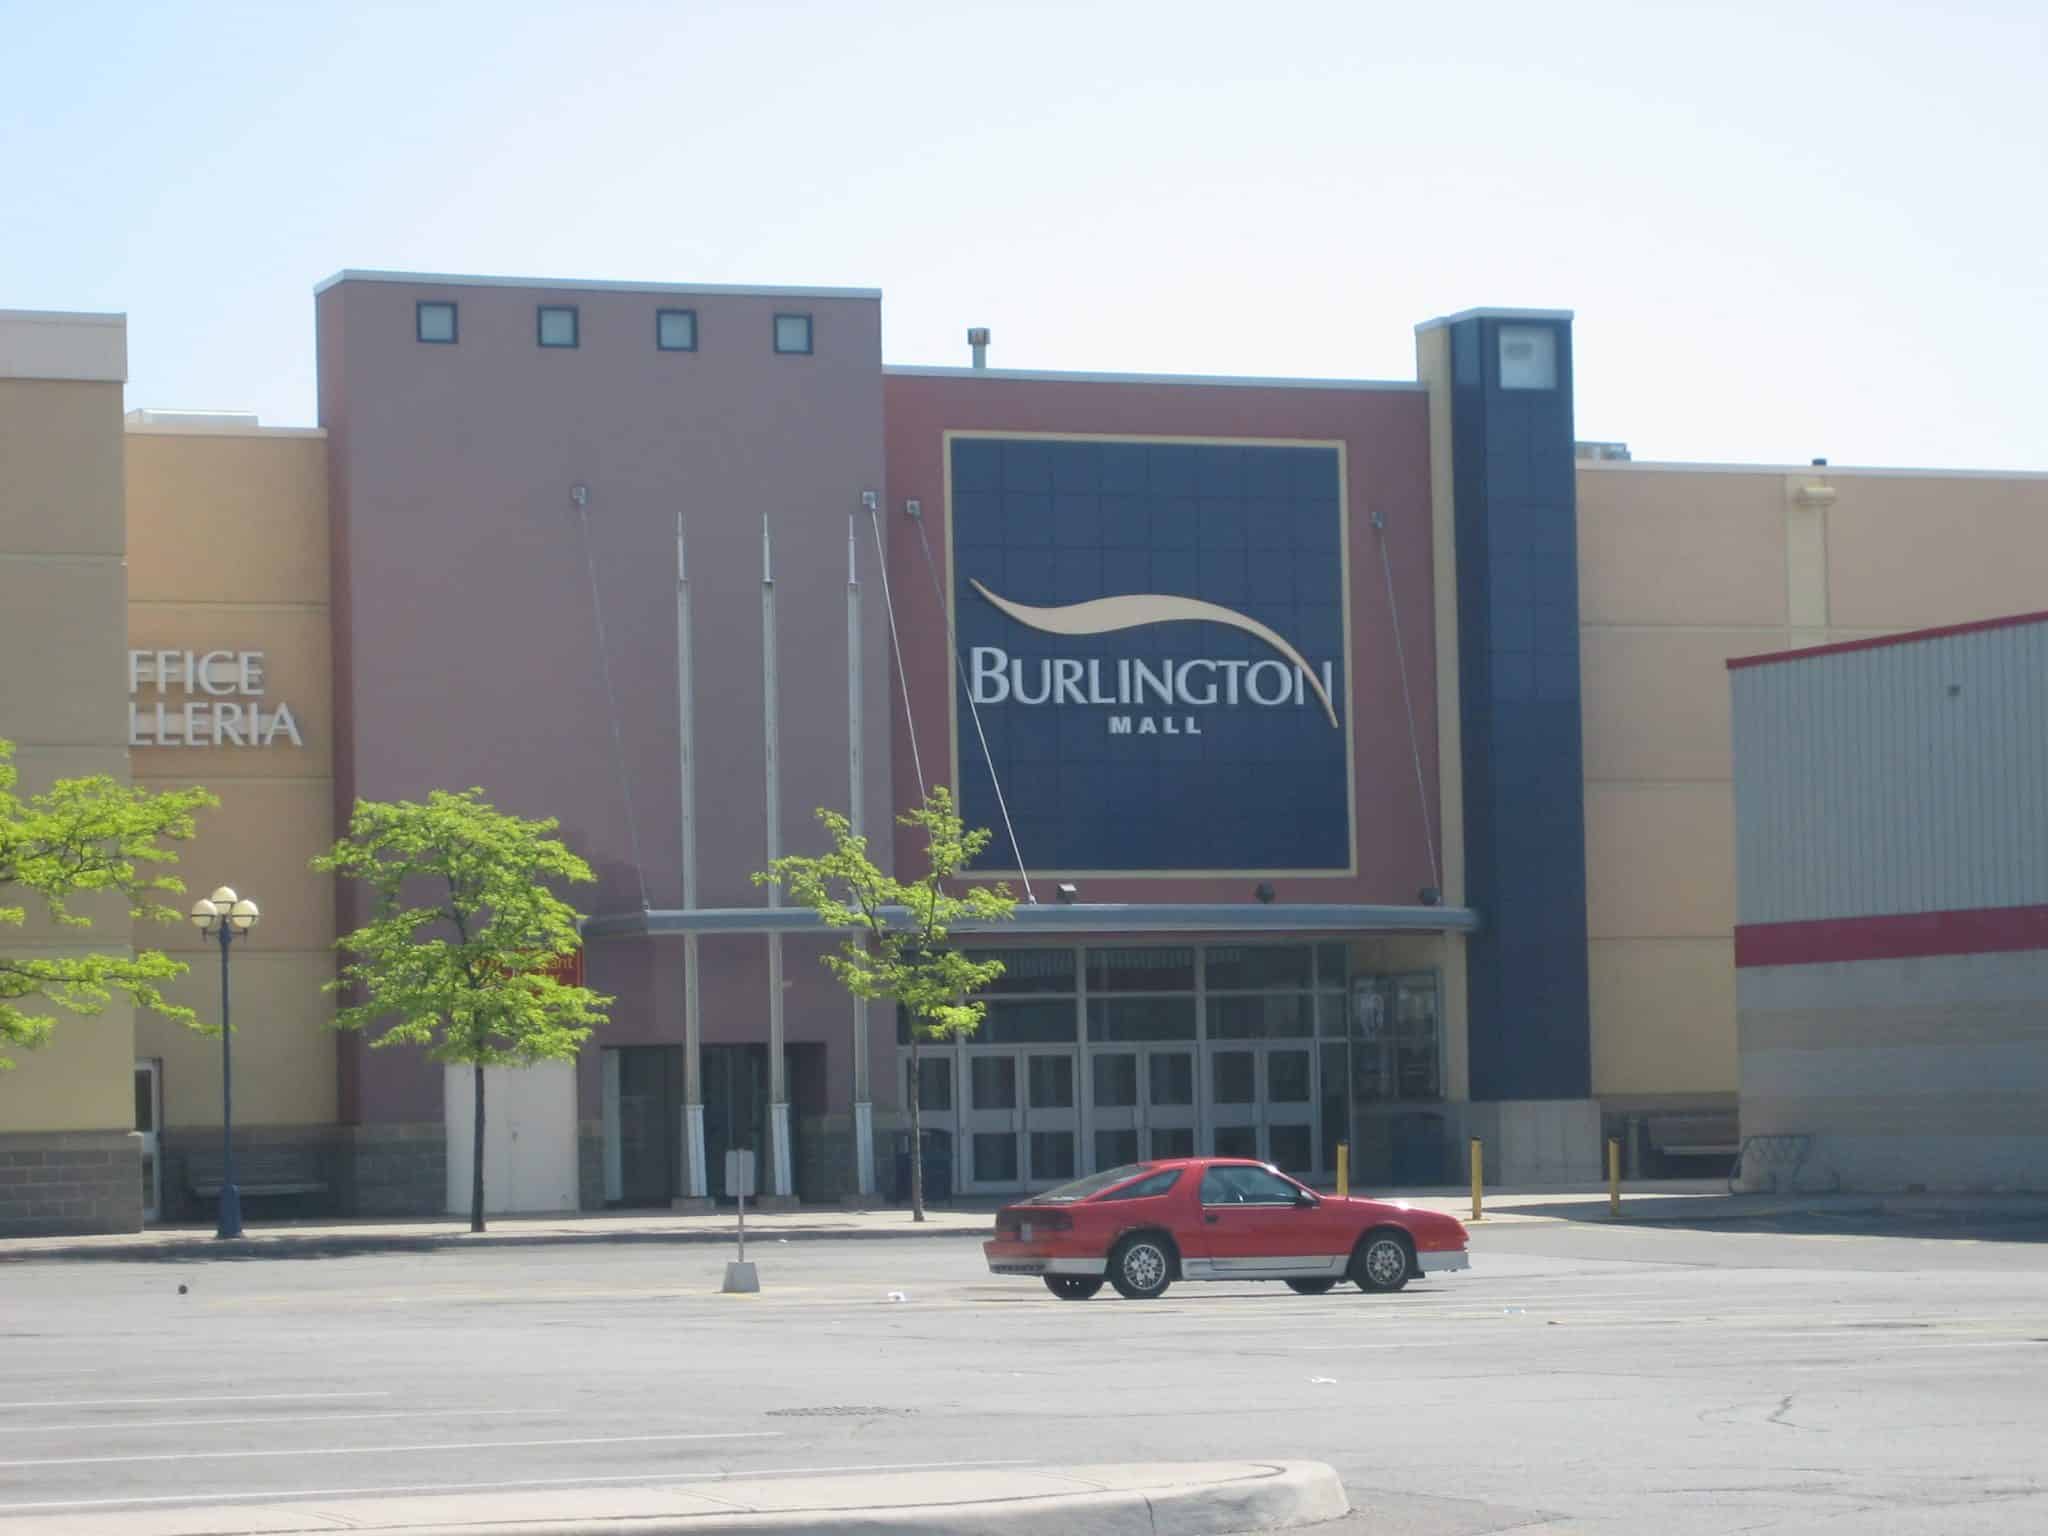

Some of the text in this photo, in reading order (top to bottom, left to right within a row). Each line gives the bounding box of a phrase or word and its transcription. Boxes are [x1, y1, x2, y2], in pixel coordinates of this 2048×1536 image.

[128, 650, 264, 695] FFICE
[971, 646, 1334, 706] BURLINGTON
[128, 701, 302, 746] LLERIA
[1108, 716, 1201, 735] MALL
